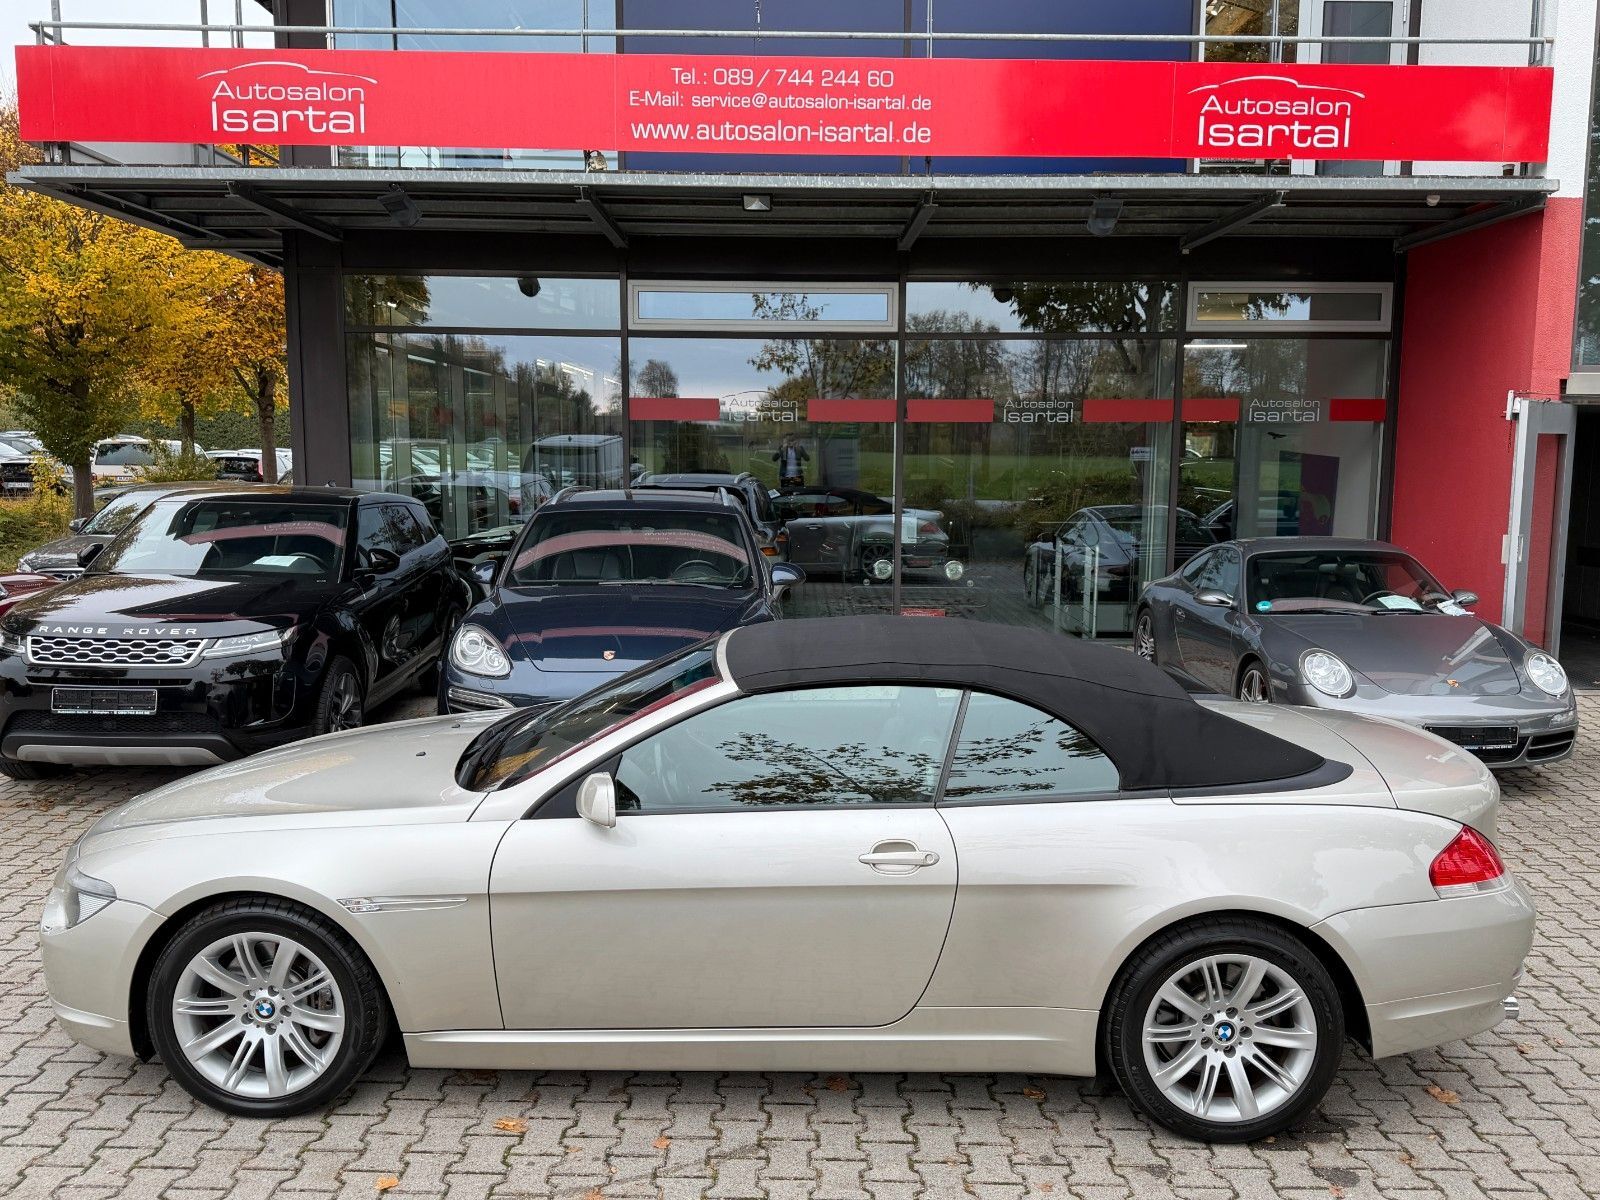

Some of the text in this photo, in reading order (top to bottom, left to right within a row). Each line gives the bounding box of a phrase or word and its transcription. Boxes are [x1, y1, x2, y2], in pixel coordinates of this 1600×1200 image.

[671, 67, 707, 85] Tel.:
[713, 67, 753, 86] 089
[774, 68, 815, 87] 744
[821, 69, 861, 87] 244
[867, 70, 895, 88] 60
[212, 80, 364, 101] Autosalon
[629, 90, 932, 111] E-Mail: service@autosalon-isartal.de
[1201, 95, 1351, 115] Autosalon
[211, 101, 365, 134] Isartal
[631, 119, 932, 144] www.autosalon-isartal.de
[1198, 115, 1351, 148] Isartal
[729, 397, 799, 408] Autosalon
[1004, 399, 1074, 409] Autosalon
[1249, 398, 1321, 408] Autosalon
[728, 408, 799, 422] Isartal
[1003, 408, 1074, 423] Isartal
[1248, 407, 1320, 422] Isartal
[38, 625, 198, 635] RANGE ROVER
